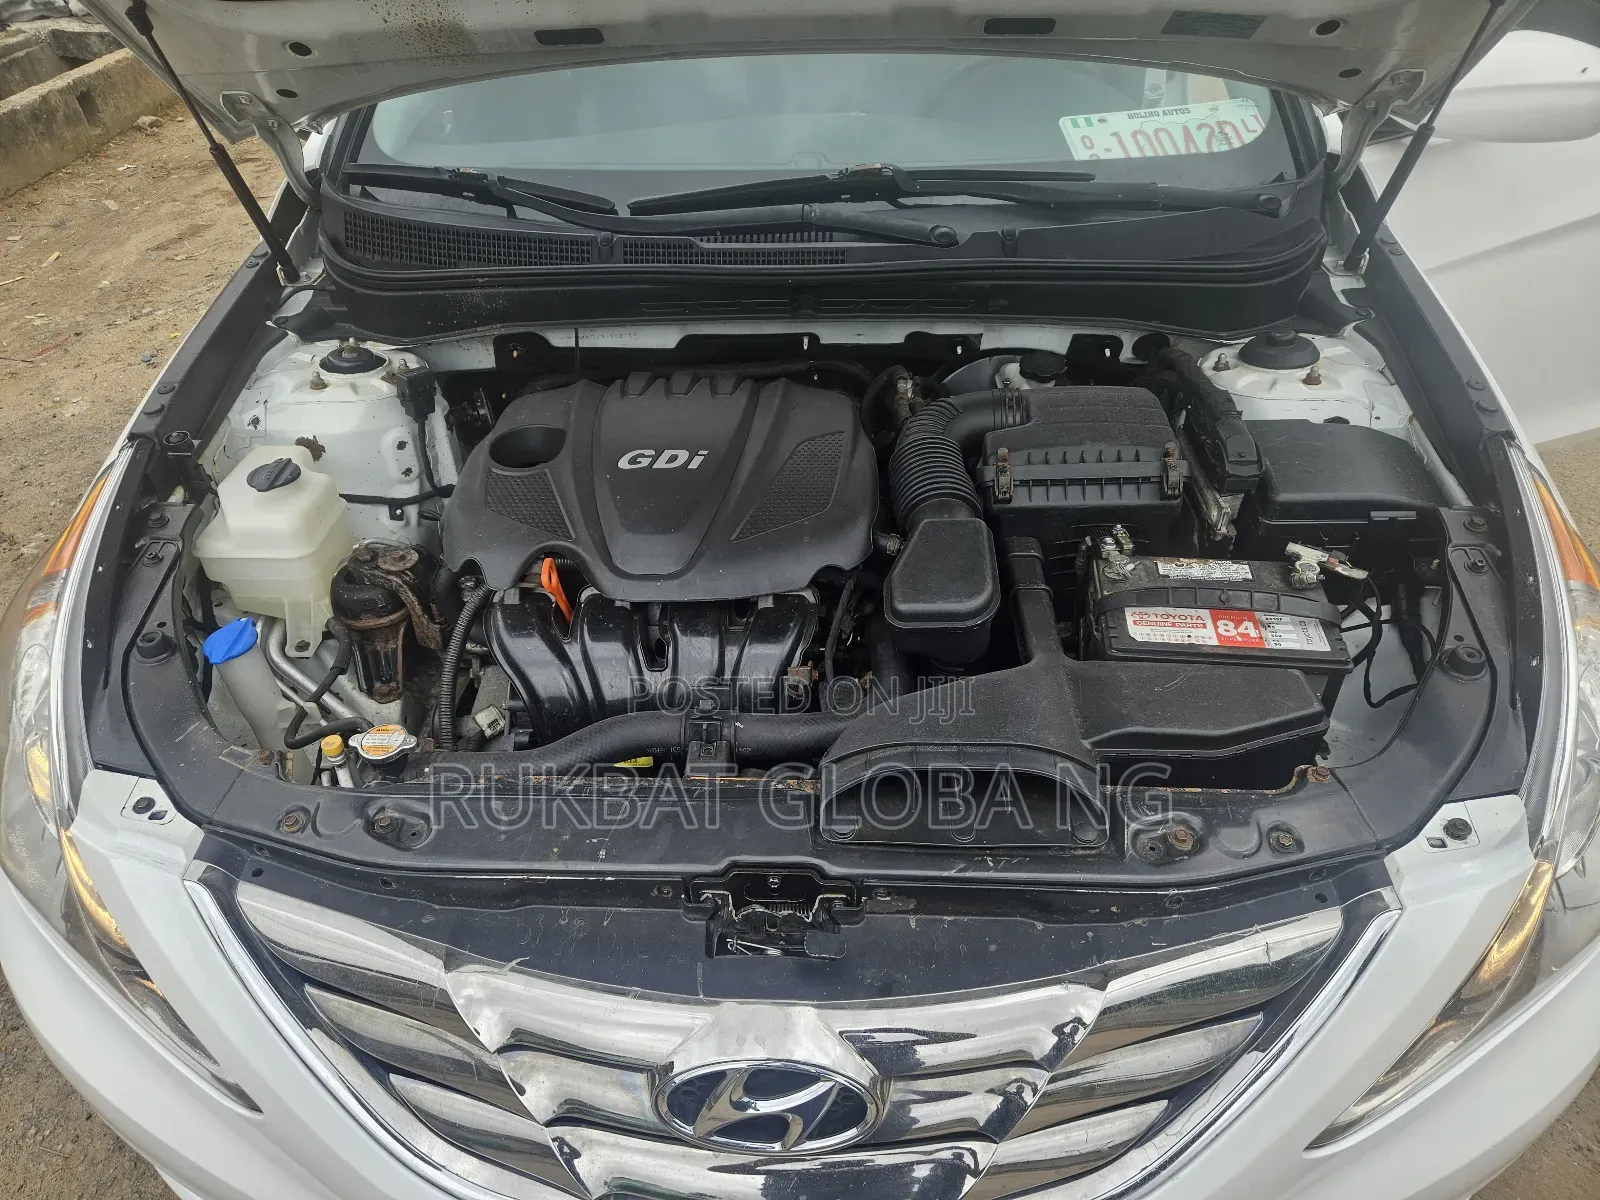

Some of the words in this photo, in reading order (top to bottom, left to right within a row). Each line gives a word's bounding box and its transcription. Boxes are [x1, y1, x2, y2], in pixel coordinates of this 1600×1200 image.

[1162, 107, 1191, 117] AUTOS
[617, 449, 710, 470] GDi
[1151, 612, 1205, 622] TOYOTA
[1136, 620, 1173, 628] GENUINE
[1216, 619, 1259, 638] 84
